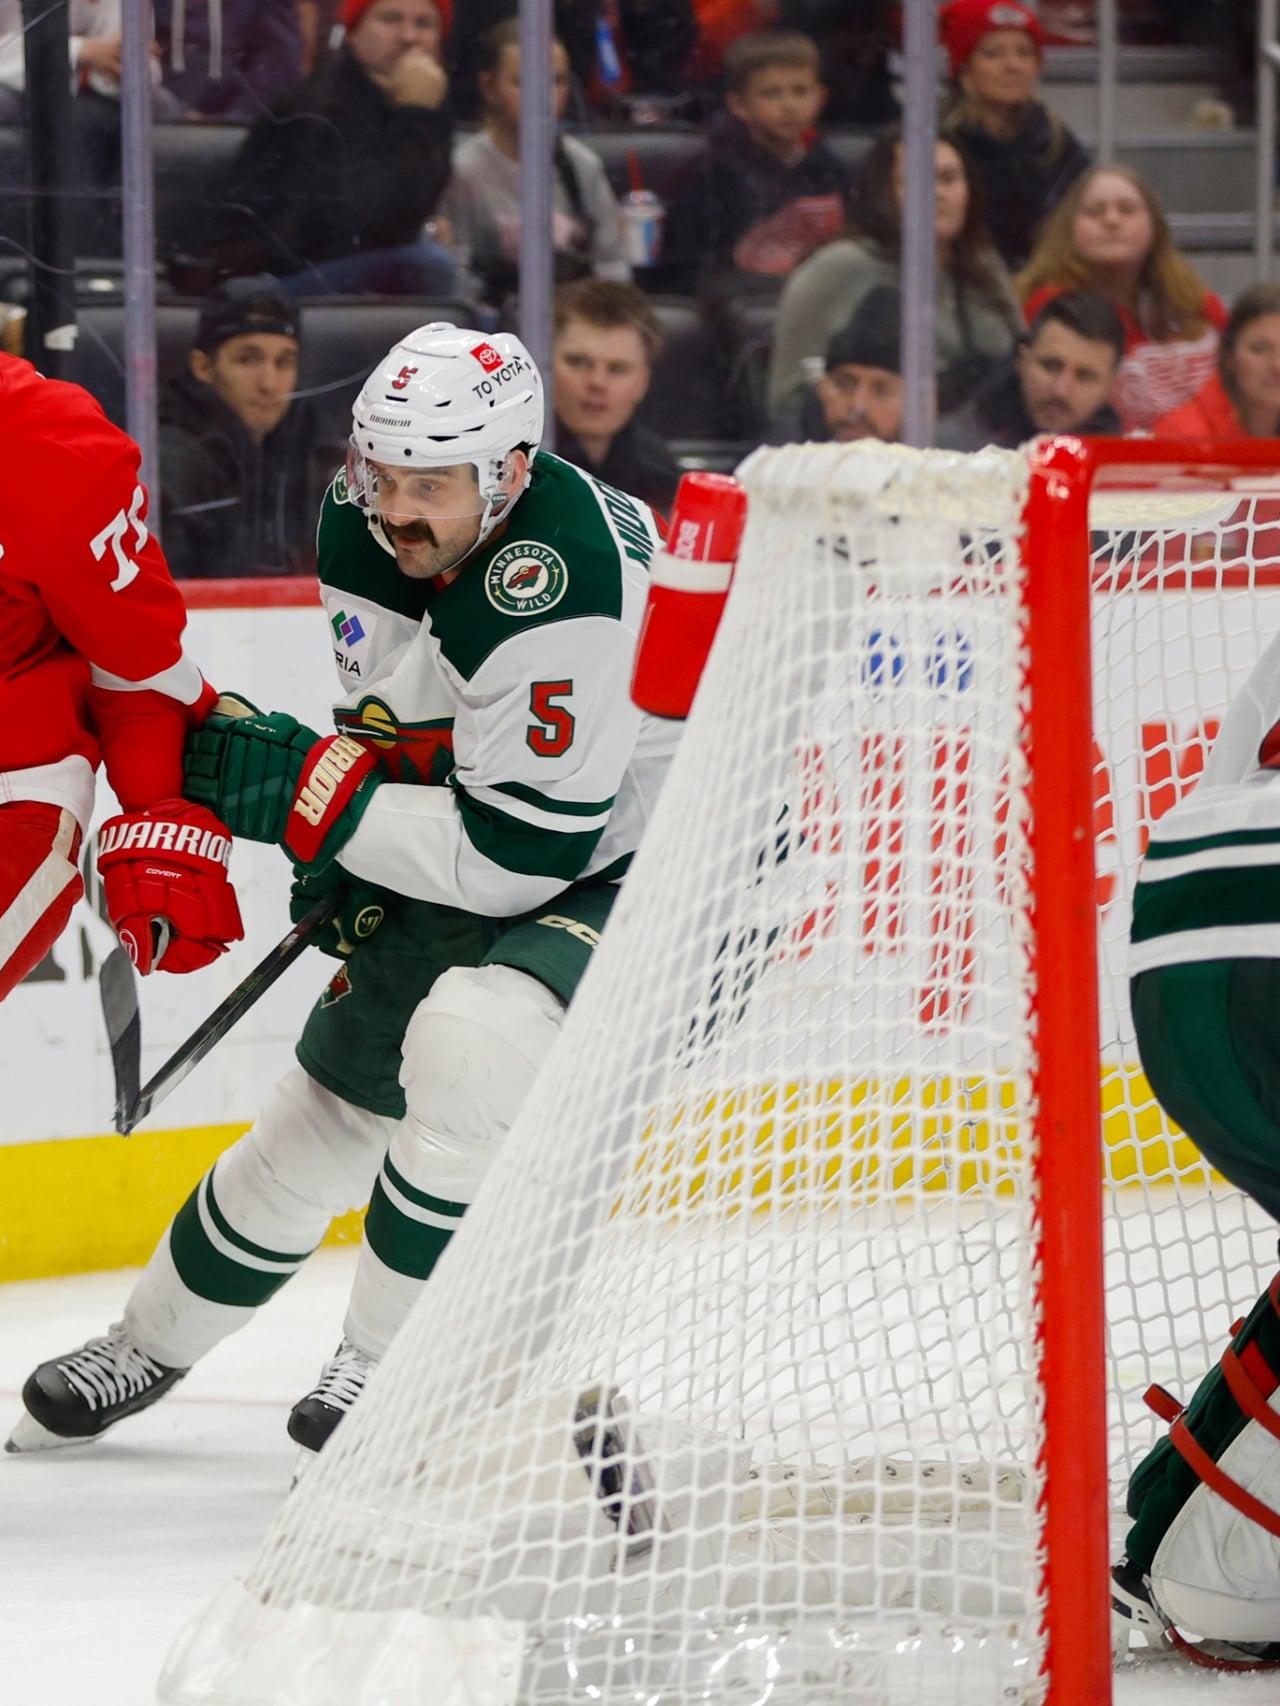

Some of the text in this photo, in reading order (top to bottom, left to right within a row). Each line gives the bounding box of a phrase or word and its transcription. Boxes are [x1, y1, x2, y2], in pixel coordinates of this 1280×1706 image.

[391, 366, 418, 389] 5
[472, 357, 524, 399] TOYOTA
[490, 546, 554, 585] MINNESOTA
[516, 593, 552, 611] WILD
[334, 648, 361, 677] RIA
[526, 679, 575, 758] 5
[145, 867, 182, 879] COVERT
[536, 915, 602, 951] CC
